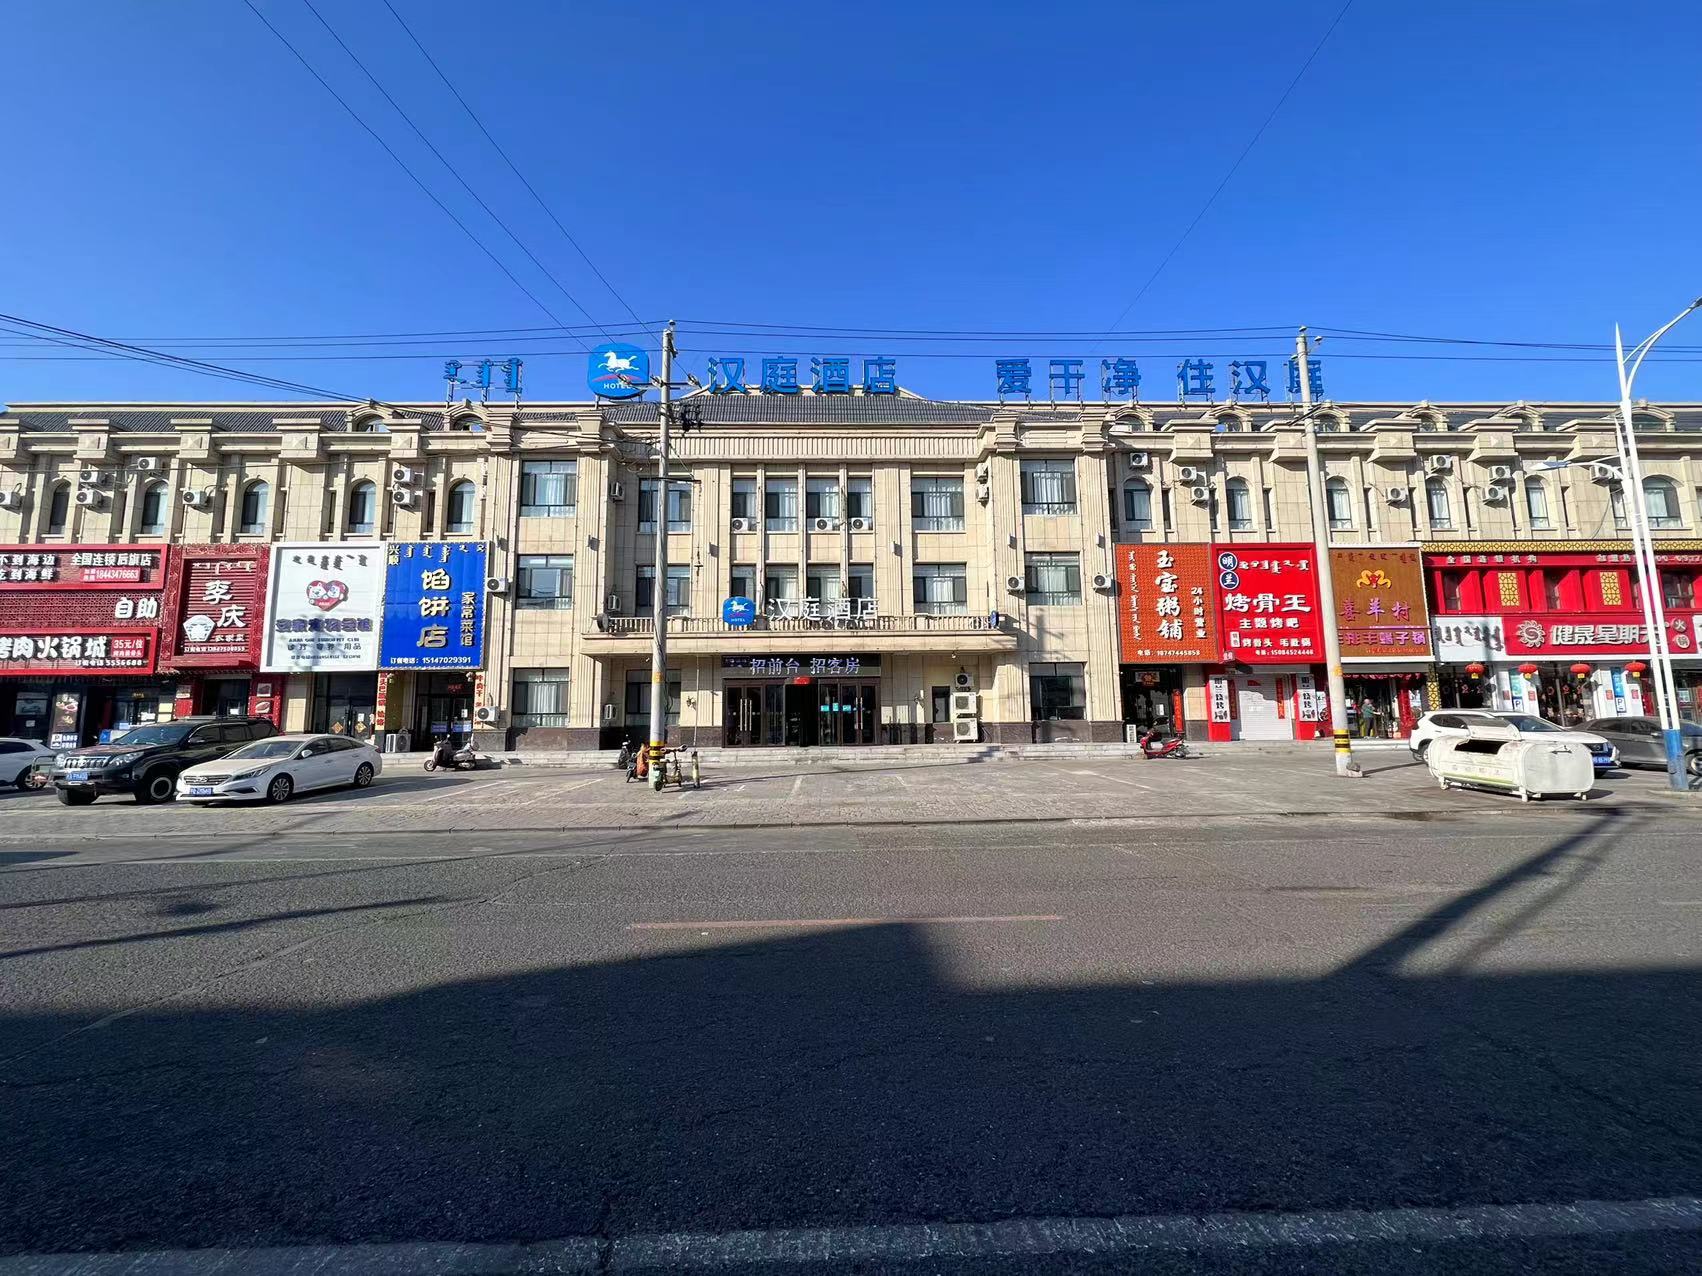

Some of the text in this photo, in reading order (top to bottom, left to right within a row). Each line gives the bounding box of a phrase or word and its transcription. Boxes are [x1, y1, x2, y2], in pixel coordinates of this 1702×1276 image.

[708, 356, 896, 394] 汉庭酒店
[995, 358, 1324, 394] 爱干净 住汉庭
[71, 553, 152, 566] 全国连锁后旗店
[1221, 555, 1236, 586] 明兰
[115, 597, 158, 618] 自助
[416, 568, 450, 648] 馅饼店
[768, 596, 879, 621] 汉庭酒店
[1155, 550, 1183, 640] 玉宝粥铺
[1224, 593, 1312, 613] 烤骨王
[461, 592, 475, 646] 家常菜馆
[1338, 598, 1411, 622] 喜羊村
[750, 657, 800, 675] 招前台
[810, 657, 861, 675] 招客房
